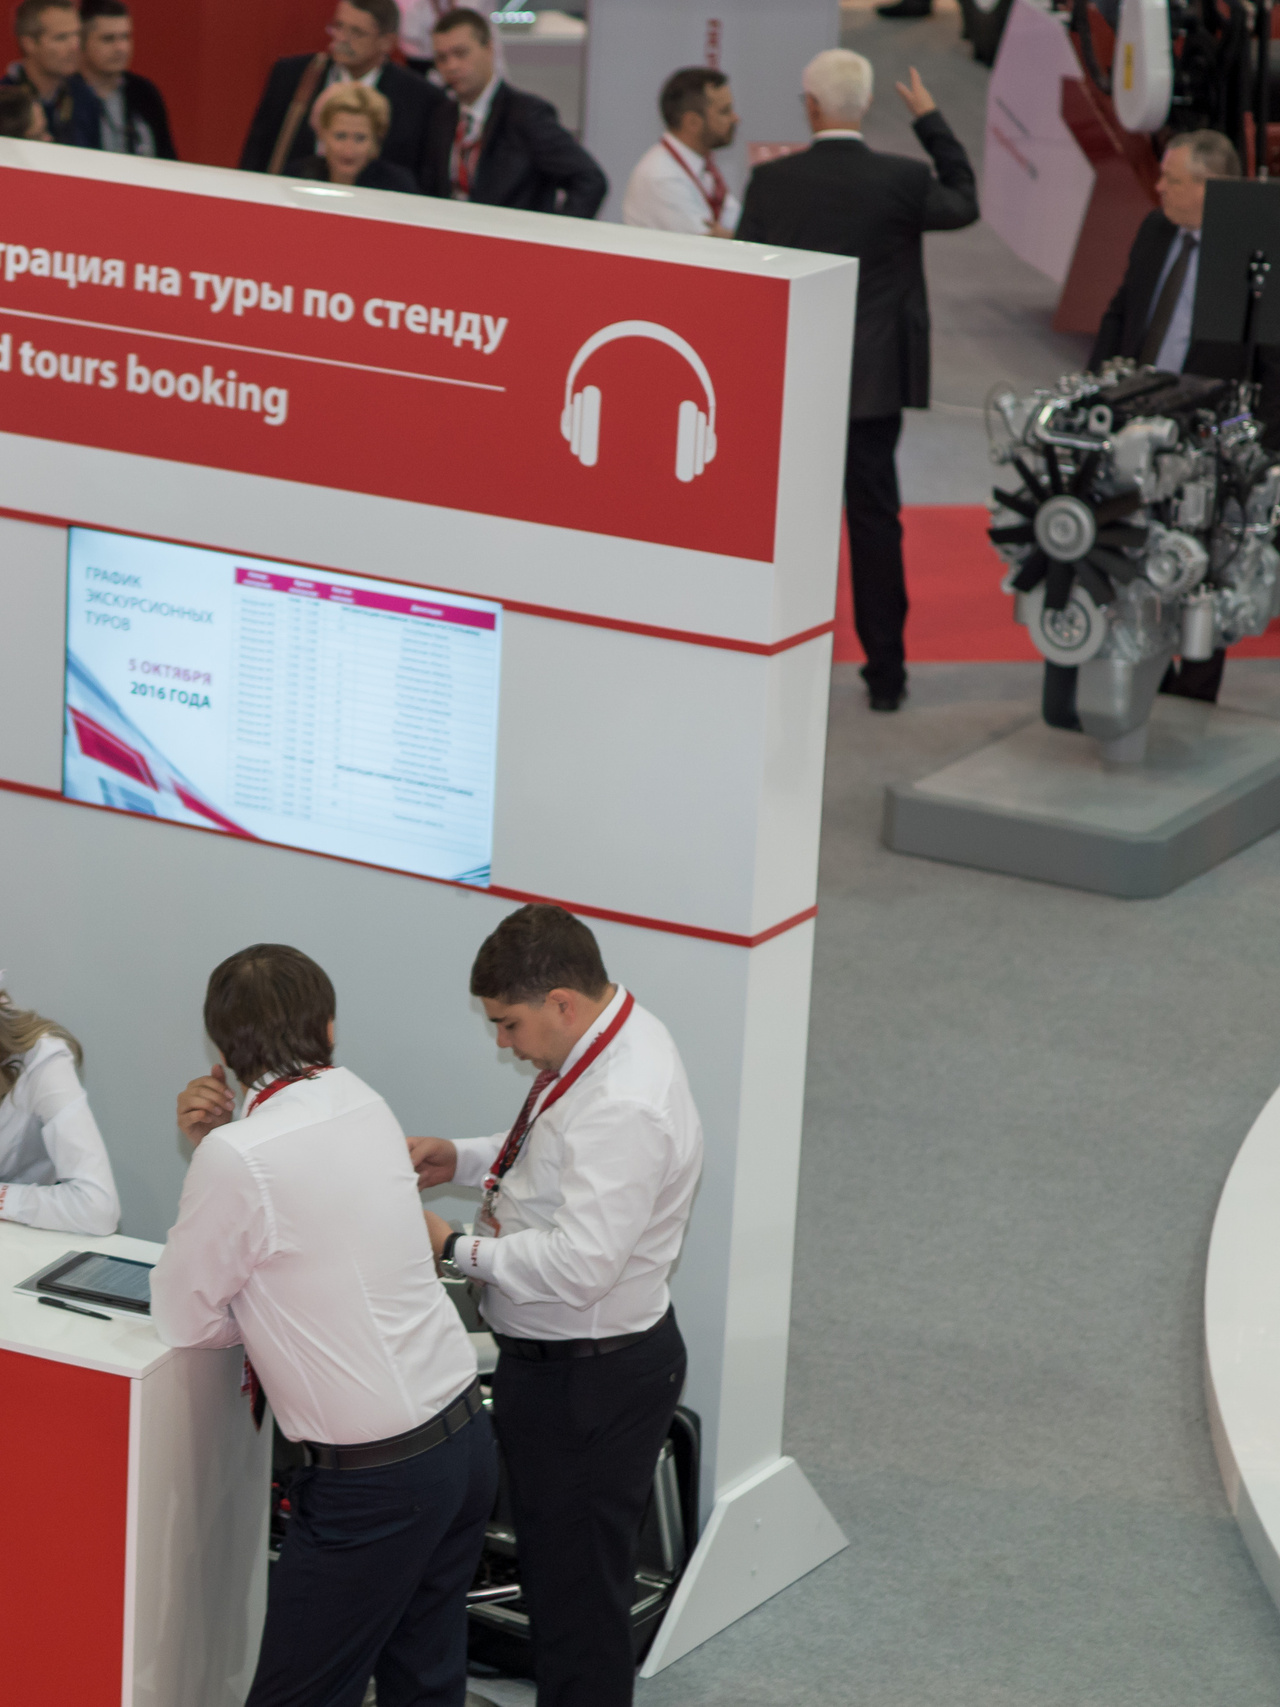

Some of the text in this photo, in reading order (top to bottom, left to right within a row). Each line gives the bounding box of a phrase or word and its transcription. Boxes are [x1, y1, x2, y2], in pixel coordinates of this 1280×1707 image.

[134, 263, 183, 297] на
[189, 271, 295, 317] туры
[303, 287, 356, 323] по
[362, 297, 509, 356] стенду
[18, 340, 119, 389] tours
[126, 352, 289, 427] booking
[86, 566, 142, 588] ГРАФИК
[85, 588, 214, 624] ЭКСКУРСИОННЫХ
[85, 610, 131, 631] ТУРОВ
[129, 658, 212, 685] 5 ОКТЯБРЯ
[130, 681, 211, 709] 2016 ГОДА
